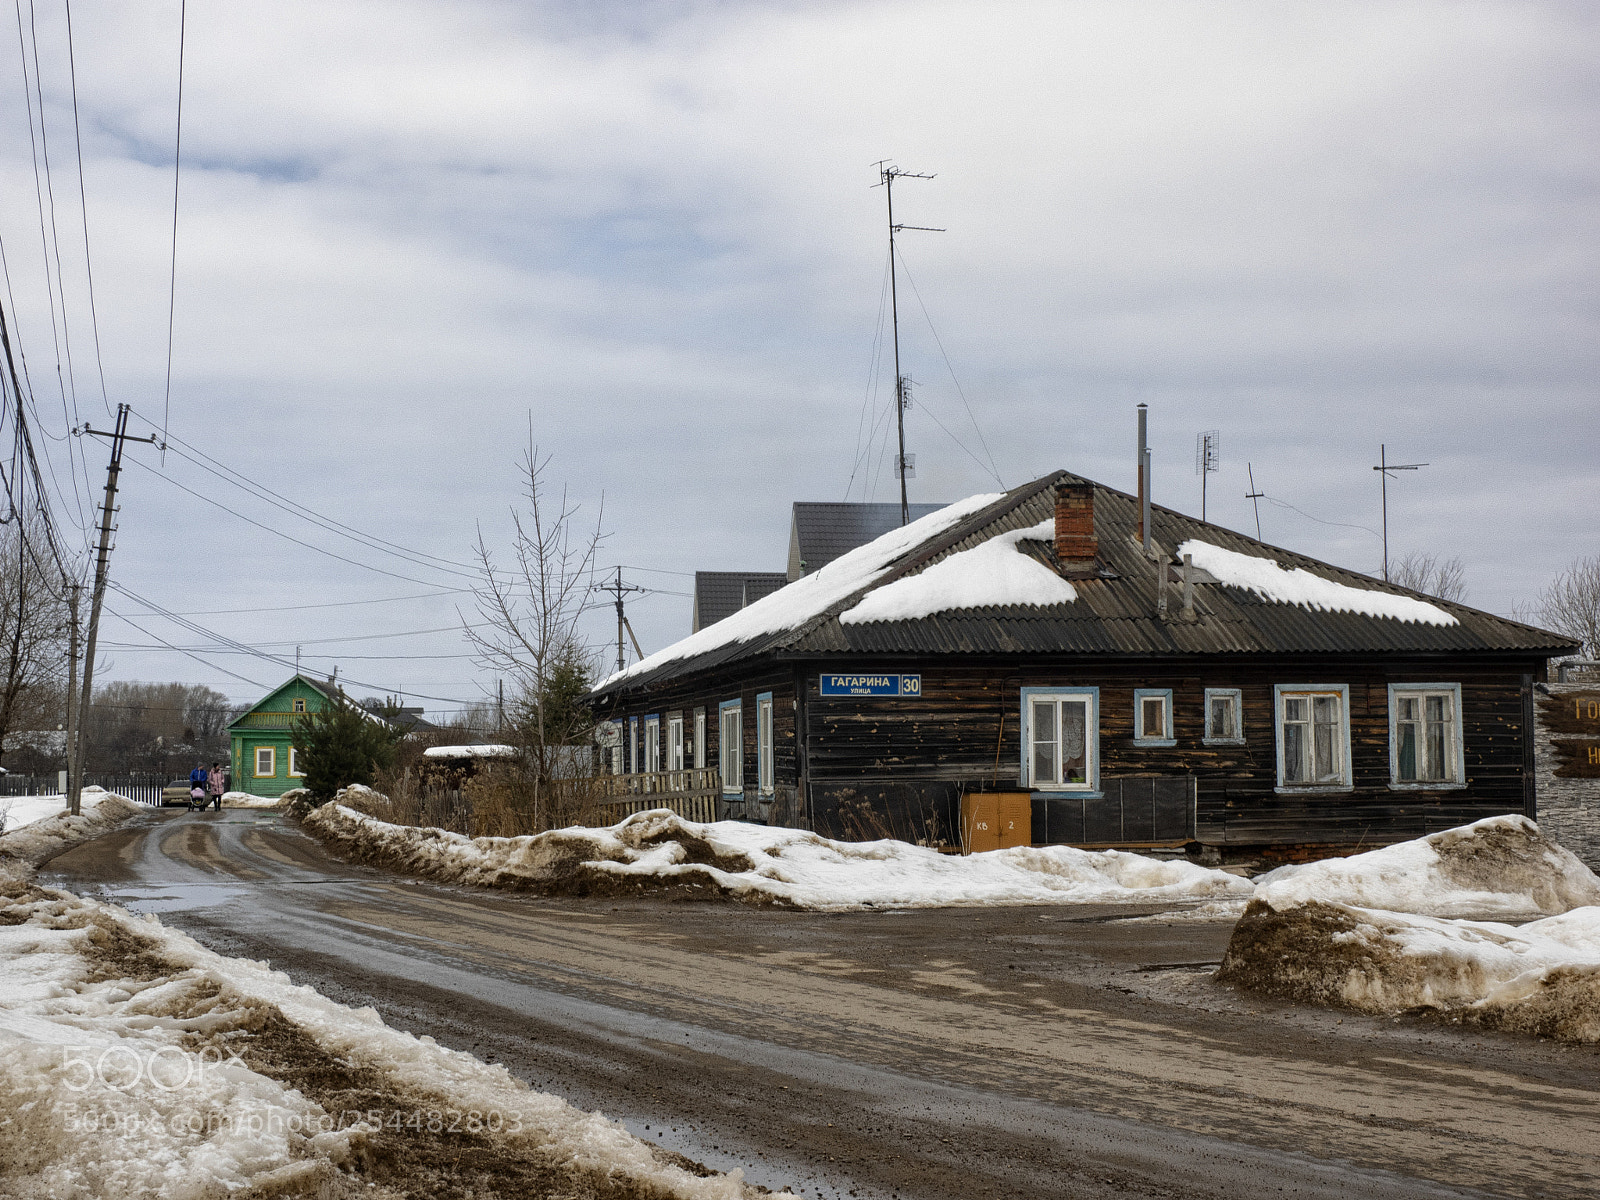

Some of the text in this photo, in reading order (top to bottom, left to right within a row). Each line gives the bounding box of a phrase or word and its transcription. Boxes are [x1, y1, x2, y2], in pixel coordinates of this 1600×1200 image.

[831, 677, 890, 687] ГАГАРИНА
[903, 678, 919, 693] 30
[1575, 698, 1600, 719] ГО
[1009, 820, 1014, 829] 2
